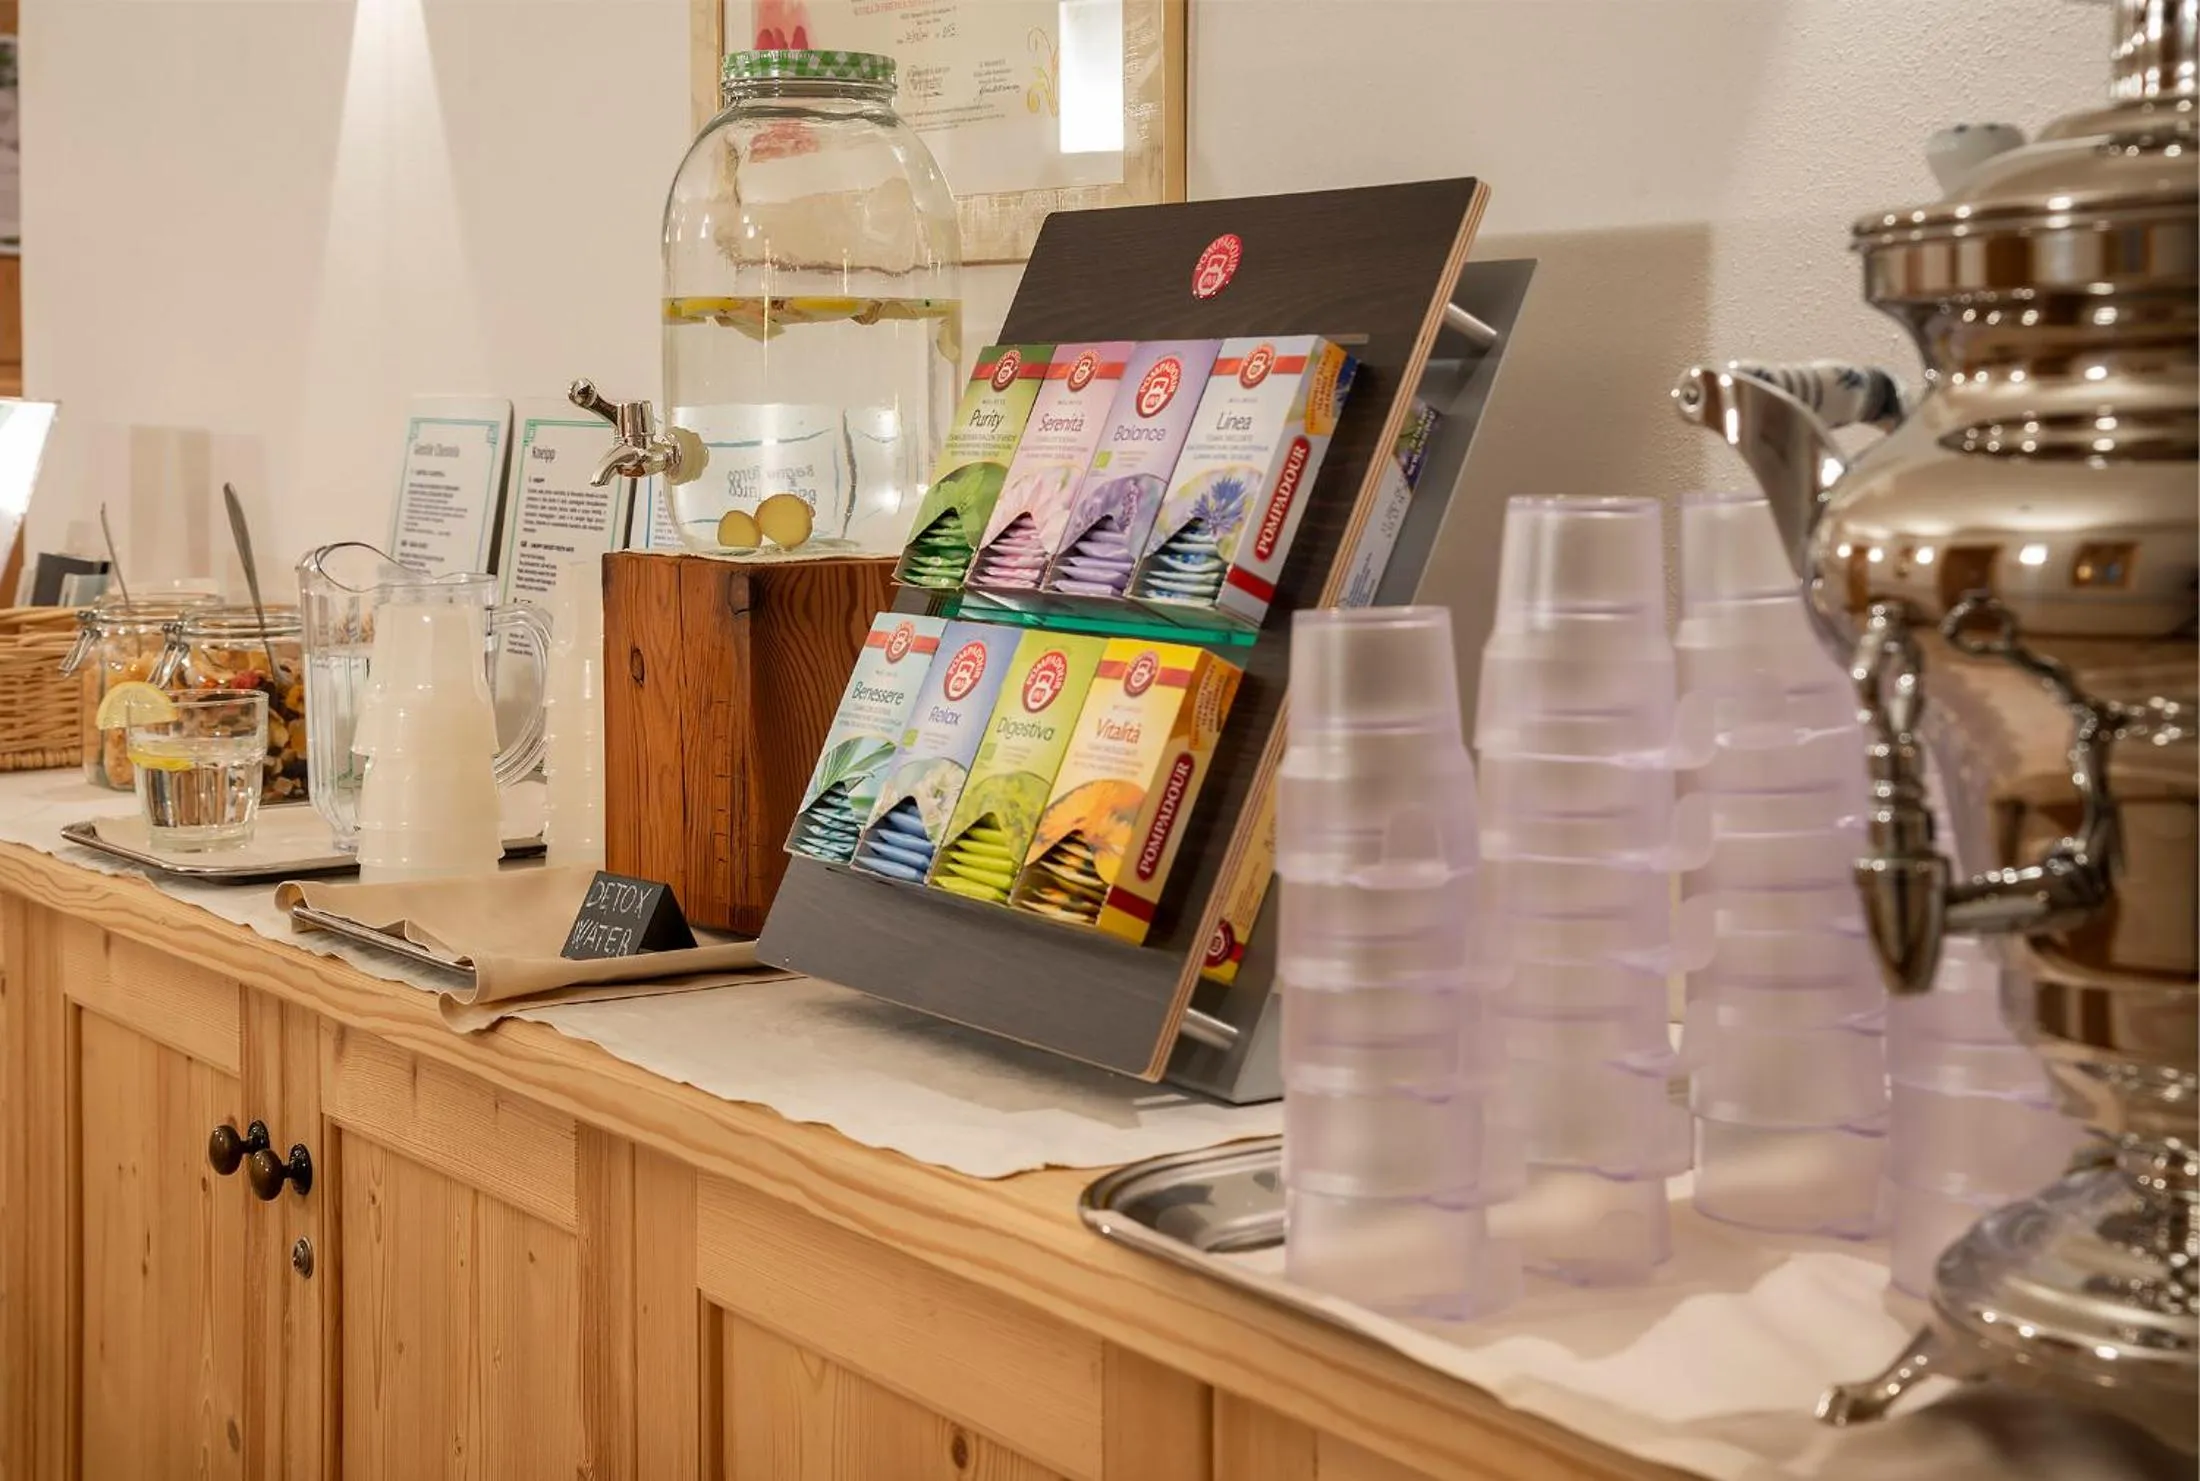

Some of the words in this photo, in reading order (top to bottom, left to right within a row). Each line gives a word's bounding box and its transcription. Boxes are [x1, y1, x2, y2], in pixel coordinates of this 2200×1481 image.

[969, 409, 1005, 433] Purity
[1038, 412, 1085, 433] Serenità
[1113, 424, 1167, 442] Balance
[1215, 411, 1253, 431] Linea
[1256, 444, 1307, 555] POMPADOUR
[851, 681, 905, 706] Benessere
[928, 705, 962, 726] Relax
[996, 716, 1055, 742] Digestiva
[1096, 717, 1142, 745] Vitalità
[1139, 760, 1191, 875] POMPADOUR
[586, 881, 654, 919] DETOX
[571, 918, 633, 958] WATER
